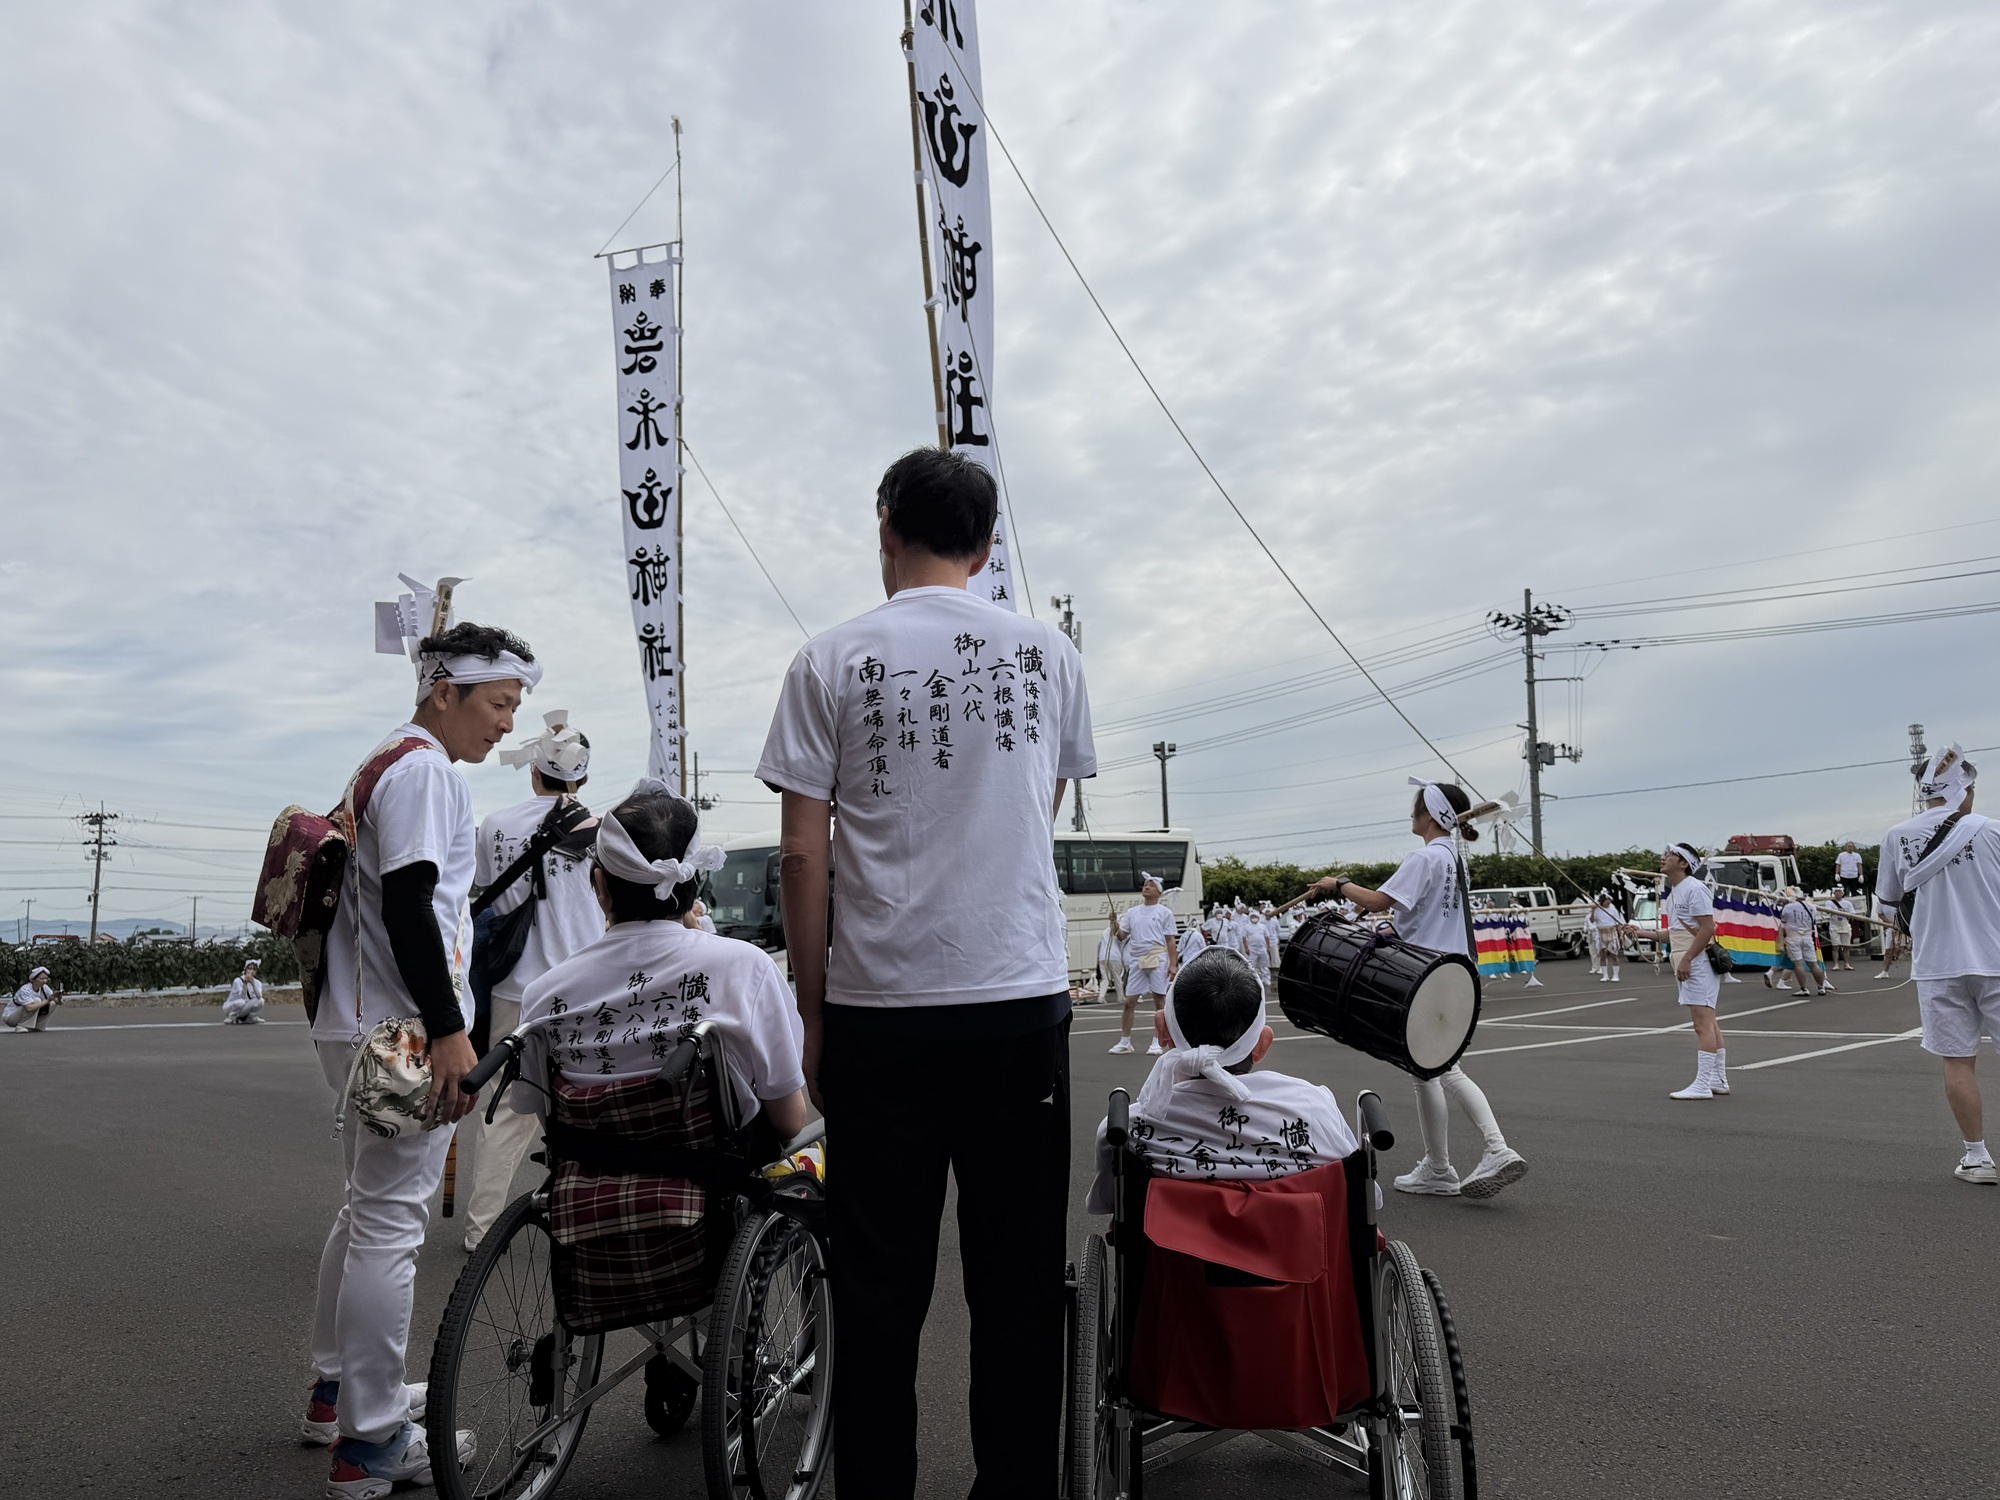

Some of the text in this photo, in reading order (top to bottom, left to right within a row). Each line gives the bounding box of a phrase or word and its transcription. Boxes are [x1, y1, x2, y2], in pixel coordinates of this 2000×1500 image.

[890, 670, 920, 752] 一々礼拝
[922, 669, 955, 769] 金剛道者
[953, 632, 986, 722] 御山八代
[987, 658, 1016, 752] 六根懺悔
[1015, 643, 1047, 744] 懺悔懺悔
